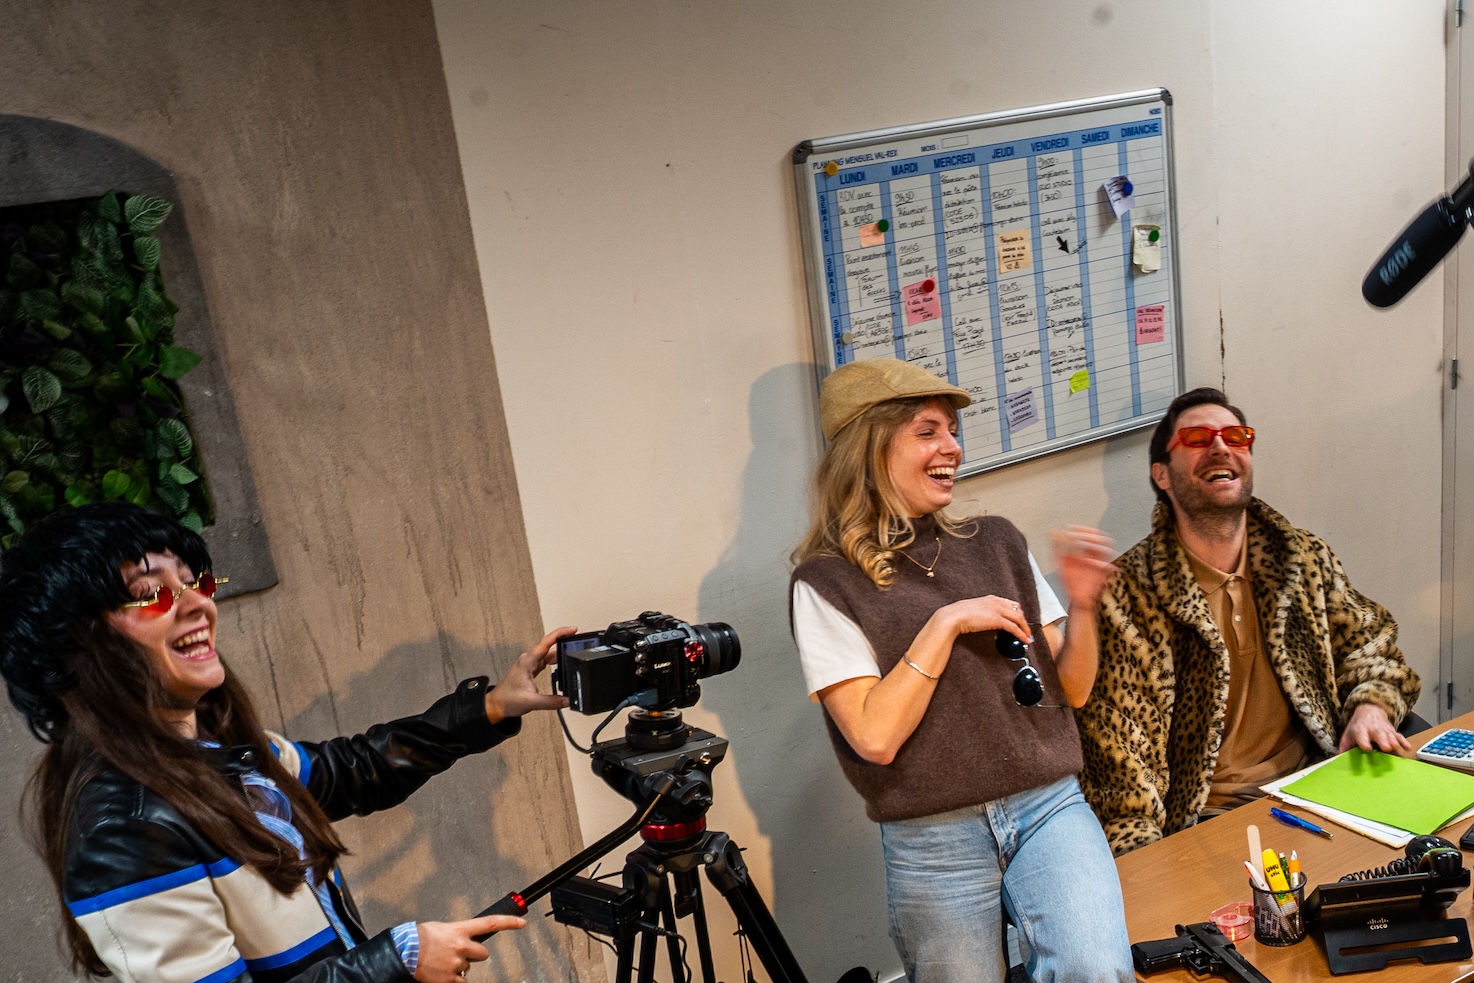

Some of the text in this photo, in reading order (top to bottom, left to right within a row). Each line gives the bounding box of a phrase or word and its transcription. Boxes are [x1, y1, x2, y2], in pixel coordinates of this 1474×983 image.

[1081, 131, 1109, 144] SAMEDI
[1121, 123, 1159, 138] DIMANCHE
[1030, 137, 1069, 152] VENDREDI
[845, 153, 874, 165] MENSUEL
[991, 146, 1014, 159] JEUDI
[934, 152, 976, 169] MERCREDI
[891, 162, 918, 176] MARDI
[840, 171, 866, 185] LUNDI
[819, 195, 830, 242] SEMAINE
[826, 258, 836, 304] SEMAINE
